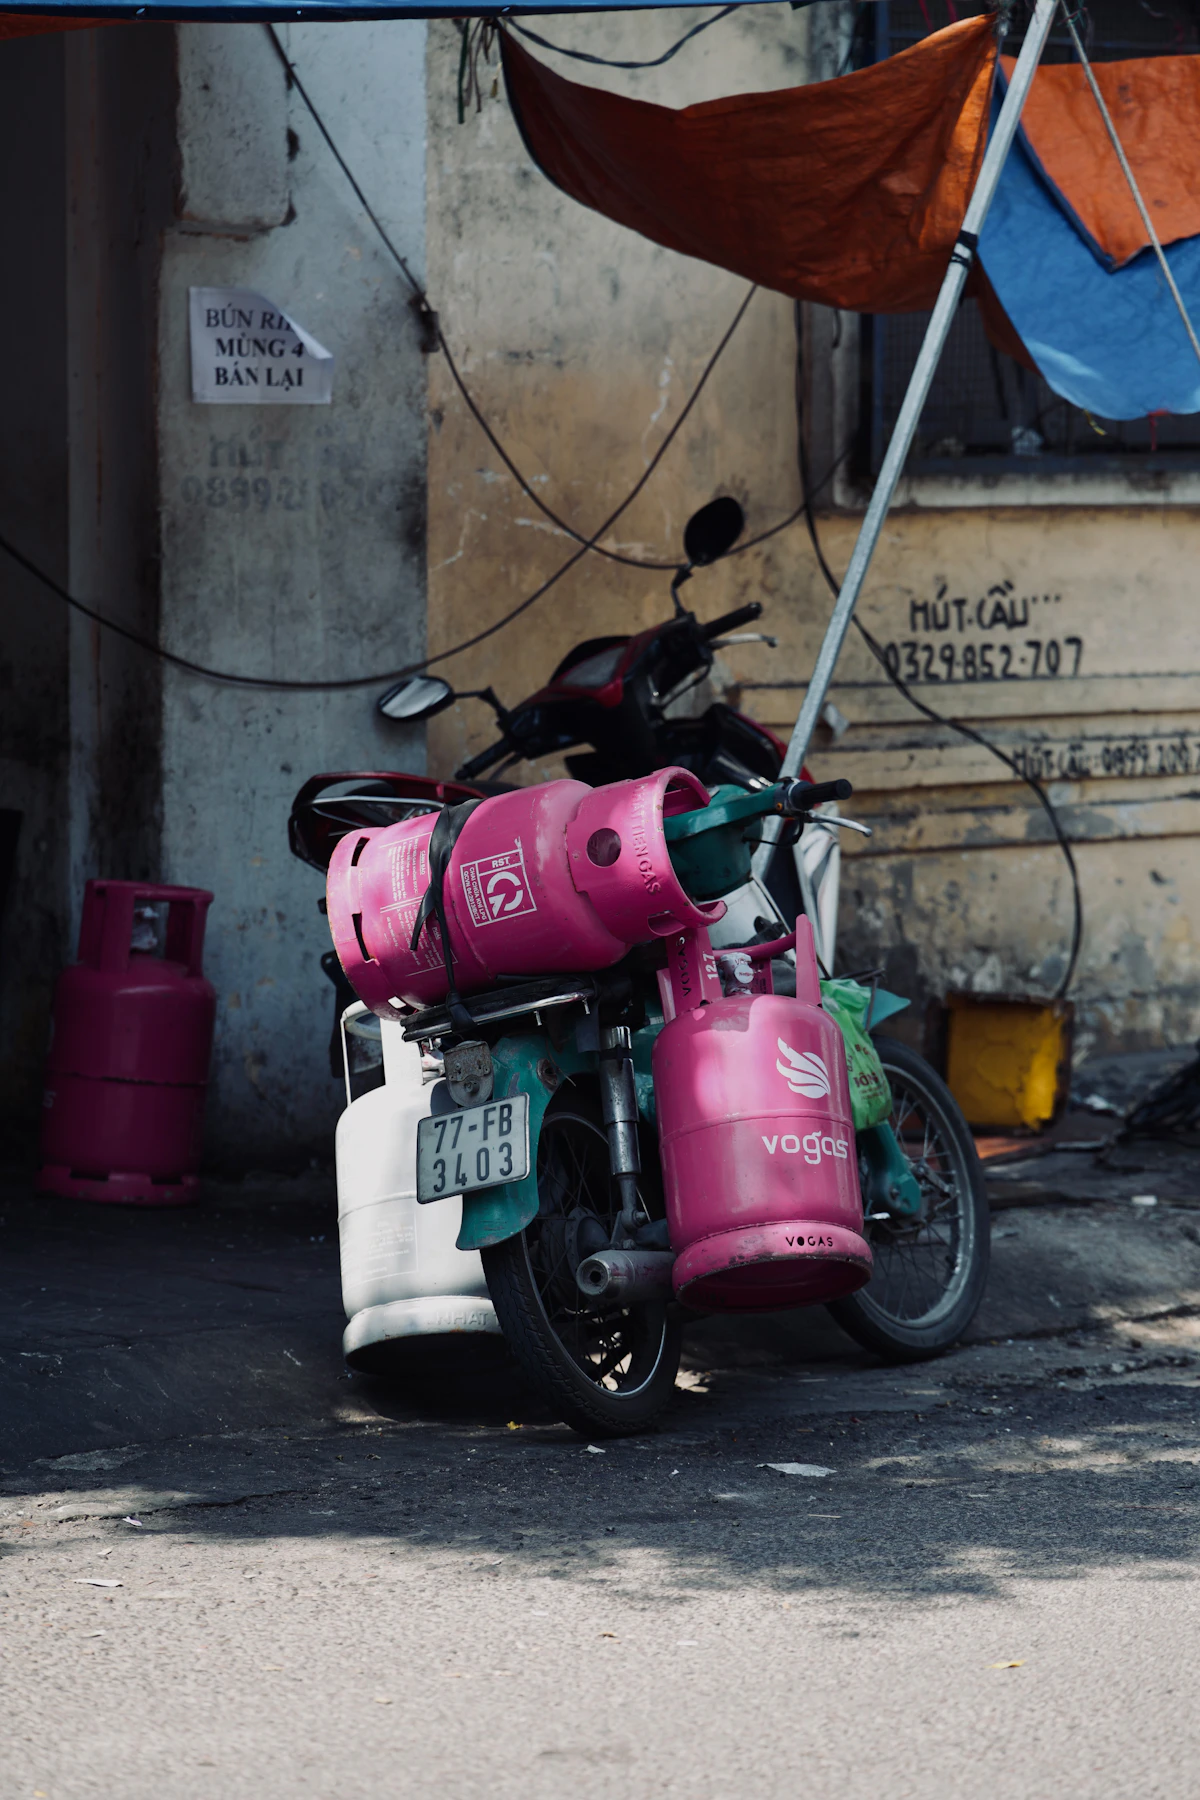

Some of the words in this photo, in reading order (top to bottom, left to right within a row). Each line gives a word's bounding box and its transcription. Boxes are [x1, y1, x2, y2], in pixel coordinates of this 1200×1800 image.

[205, 303, 253, 328] BÚN
[291, 342, 305, 358] 4
[214, 361, 259, 386] BÁN
[266, 367, 304, 391] LẠI
[492, 856, 511, 869] RST
[638, 858, 662, 895] GAS
[703, 953, 719, 980] 12.7
[433, 1103, 513, 1154] 77-FB
[761, 1130, 848, 1165] vogas
[433, 1142, 513, 1193] 3403
[785, 1236, 834, 1247] VOGAS
